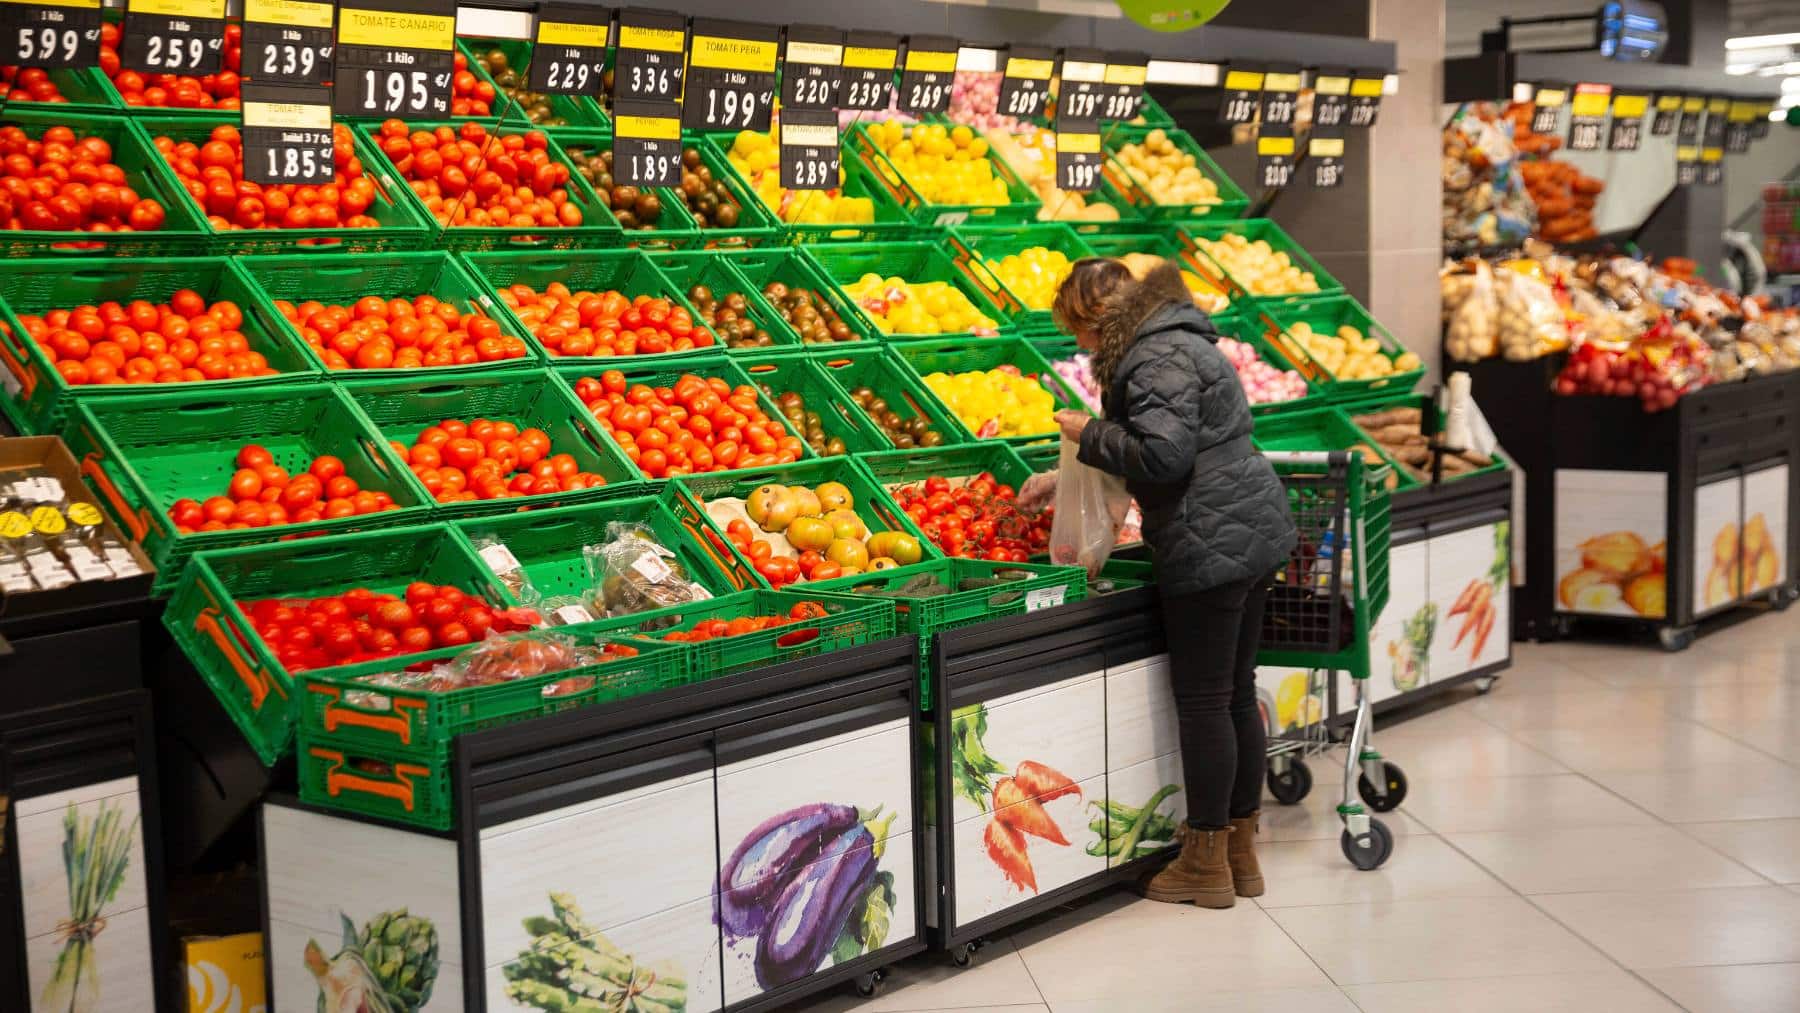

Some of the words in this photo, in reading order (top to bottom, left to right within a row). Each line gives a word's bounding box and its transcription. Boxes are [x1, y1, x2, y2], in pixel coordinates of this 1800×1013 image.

[41, 11, 46, 20] 1
[48, 11, 64, 21] kilo
[168, 21, 174, 31] 1
[352, 14, 397, 28] TOMATE
[399, 18, 446, 31] CANARIO
[706, 41, 739, 53] TOMATE
[740, 45, 761, 55] PERA
[387, 52, 392, 62] 1
[395, 52, 414, 64] kilo
[725, 73, 729, 83] 1
[731, 72, 746, 84] kilo
[434, 97, 446, 111] kg
